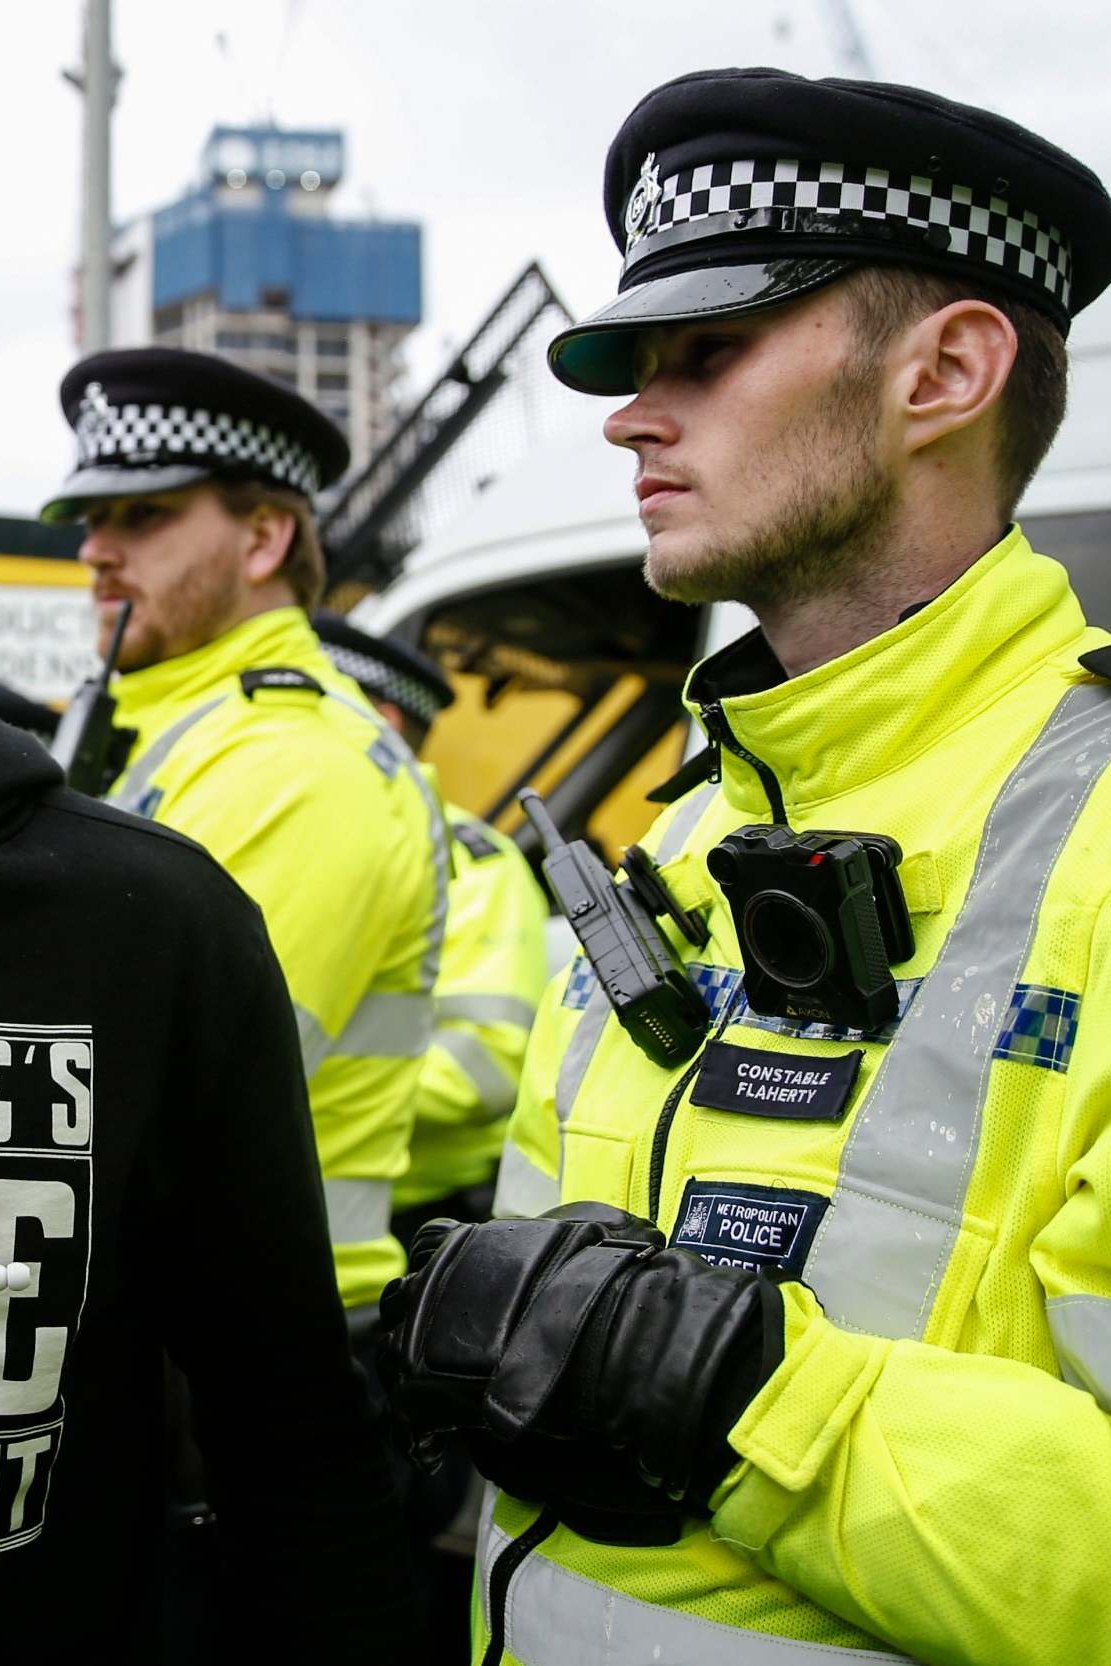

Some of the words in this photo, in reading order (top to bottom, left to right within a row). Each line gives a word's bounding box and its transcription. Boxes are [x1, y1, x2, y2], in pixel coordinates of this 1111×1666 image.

[737, 1063, 831, 1086] CONSTABLE
[736, 1082, 817, 1105] FLAHERTY
[717, 1203, 799, 1226] METROPOLITAN
[718, 1220, 782, 1247] POLICE
